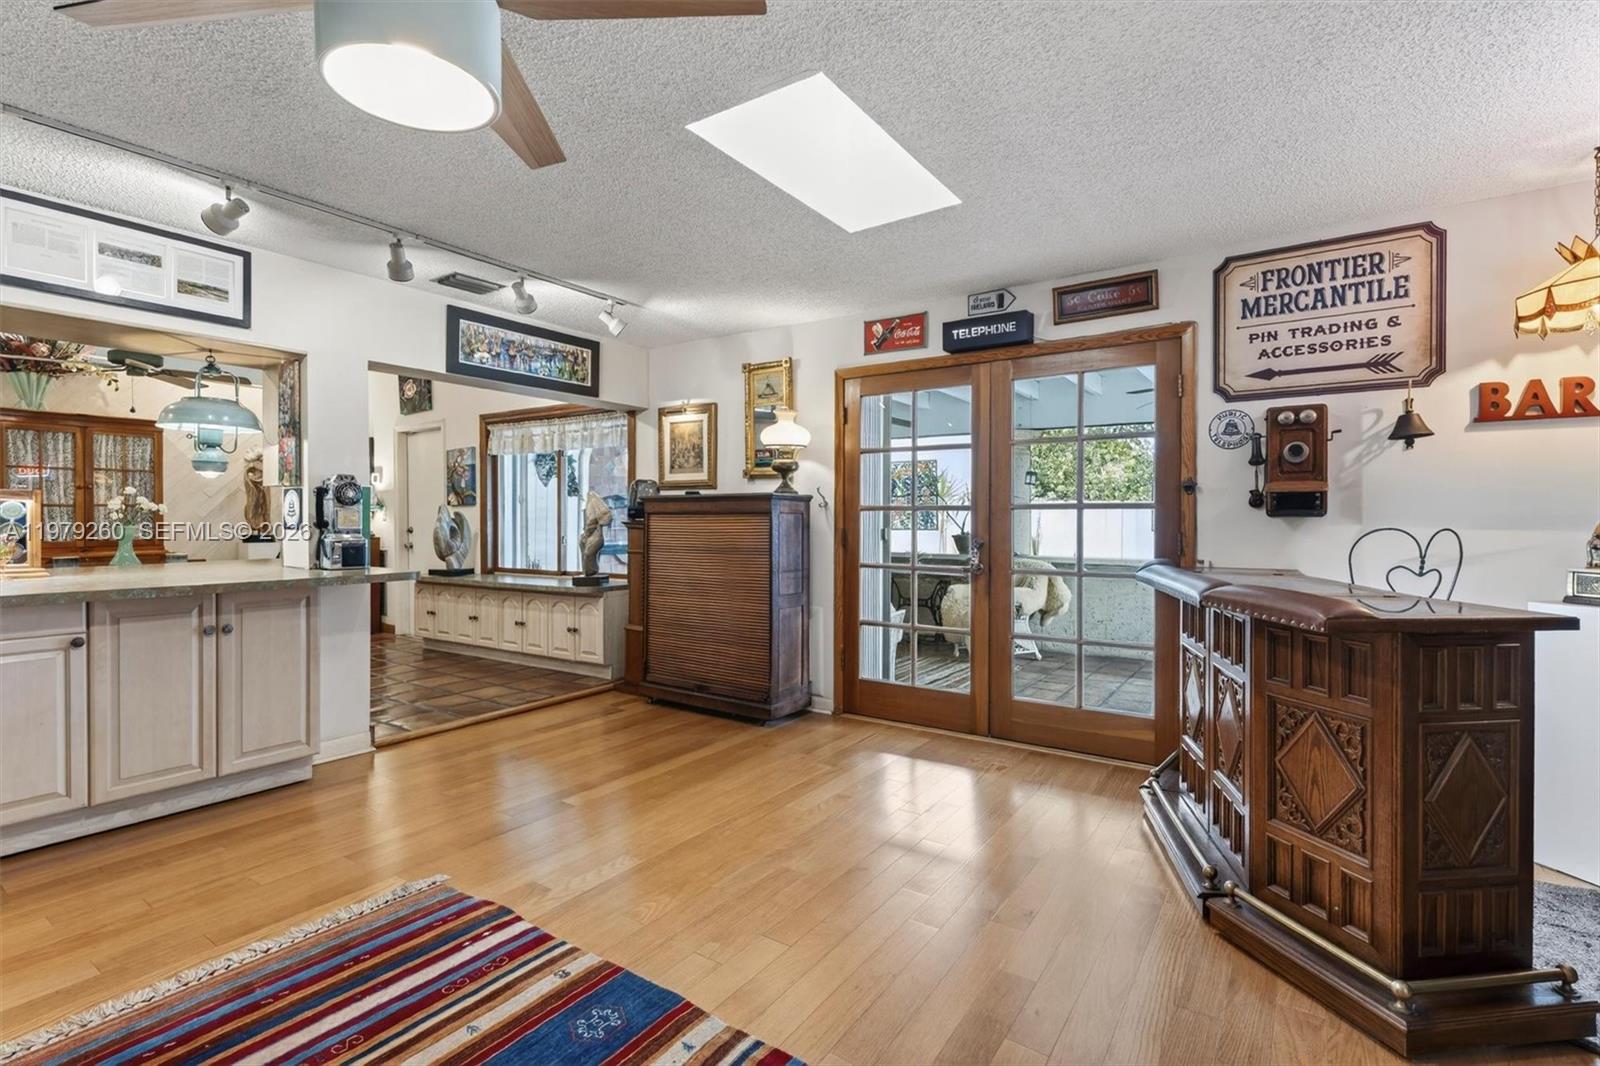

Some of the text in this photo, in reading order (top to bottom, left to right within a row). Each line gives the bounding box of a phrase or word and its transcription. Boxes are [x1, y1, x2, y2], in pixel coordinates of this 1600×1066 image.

[1261, 252, 1384, 292] FRONTIER
[1240, 275, 1410, 320] MERCANTILE
[951, 321, 1017, 340] TELEPHONE
[1248, 315, 1402, 344] PIN TRADING &
[1257, 335, 1392, 360] ACCESSORIES
[1478, 376, 1600, 420] BAR
[1217, 411, 1248, 421] PUBLIC
